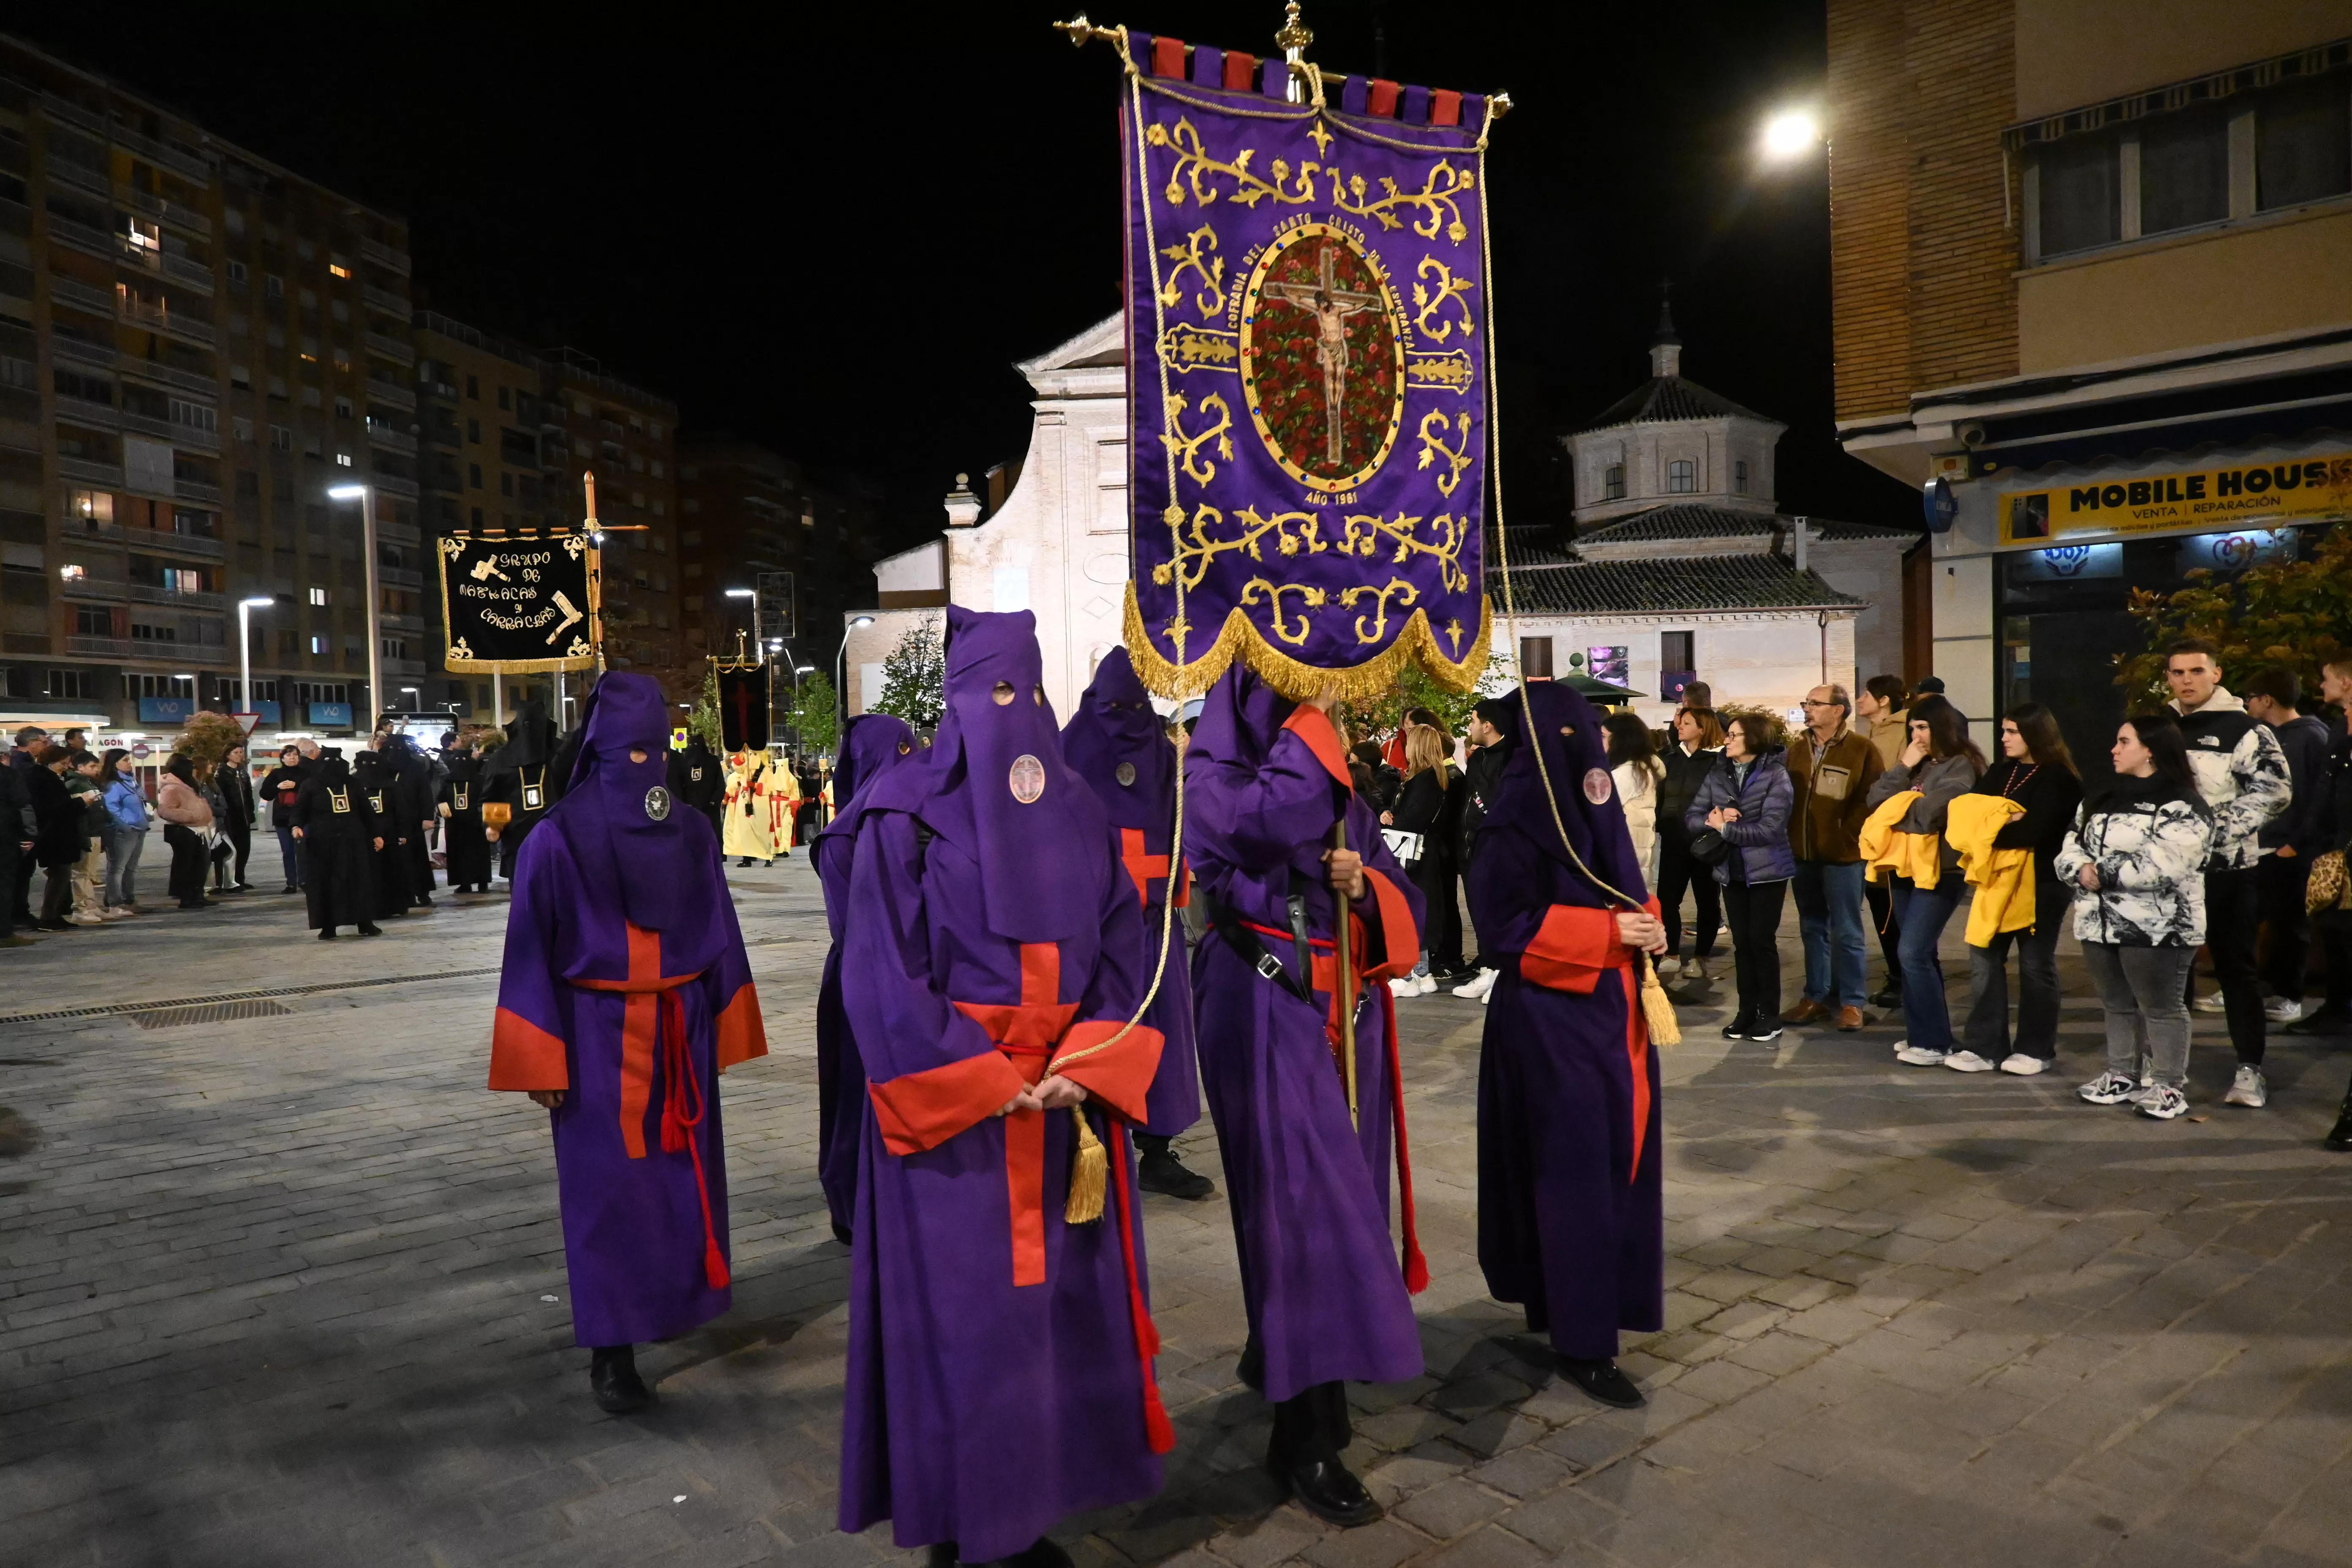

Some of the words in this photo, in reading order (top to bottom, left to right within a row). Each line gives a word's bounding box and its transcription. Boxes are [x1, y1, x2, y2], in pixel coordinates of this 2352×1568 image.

[1228, 272, 1248, 329] COFRADIA
[1242, 243, 1265, 265] DEL
[1273, 212, 1312, 237] SANTO
[1328, 214, 1365, 244] CRISTO
[1389, 286, 1415, 349] ESPERANZA
[1305, 490, 1328, 506] AÑO
[2070, 475, 2206, 512] MOBILE
[2132, 507, 2178, 519] VENTA
[2193, 495, 2281, 513] REPARACIÓN
[500, 551, 550, 567] GRUPO
[522, 568, 541, 583] DE
[460, 584, 537, 600] MATRACAS
[480, 607, 555, 630] CARRACLAS
